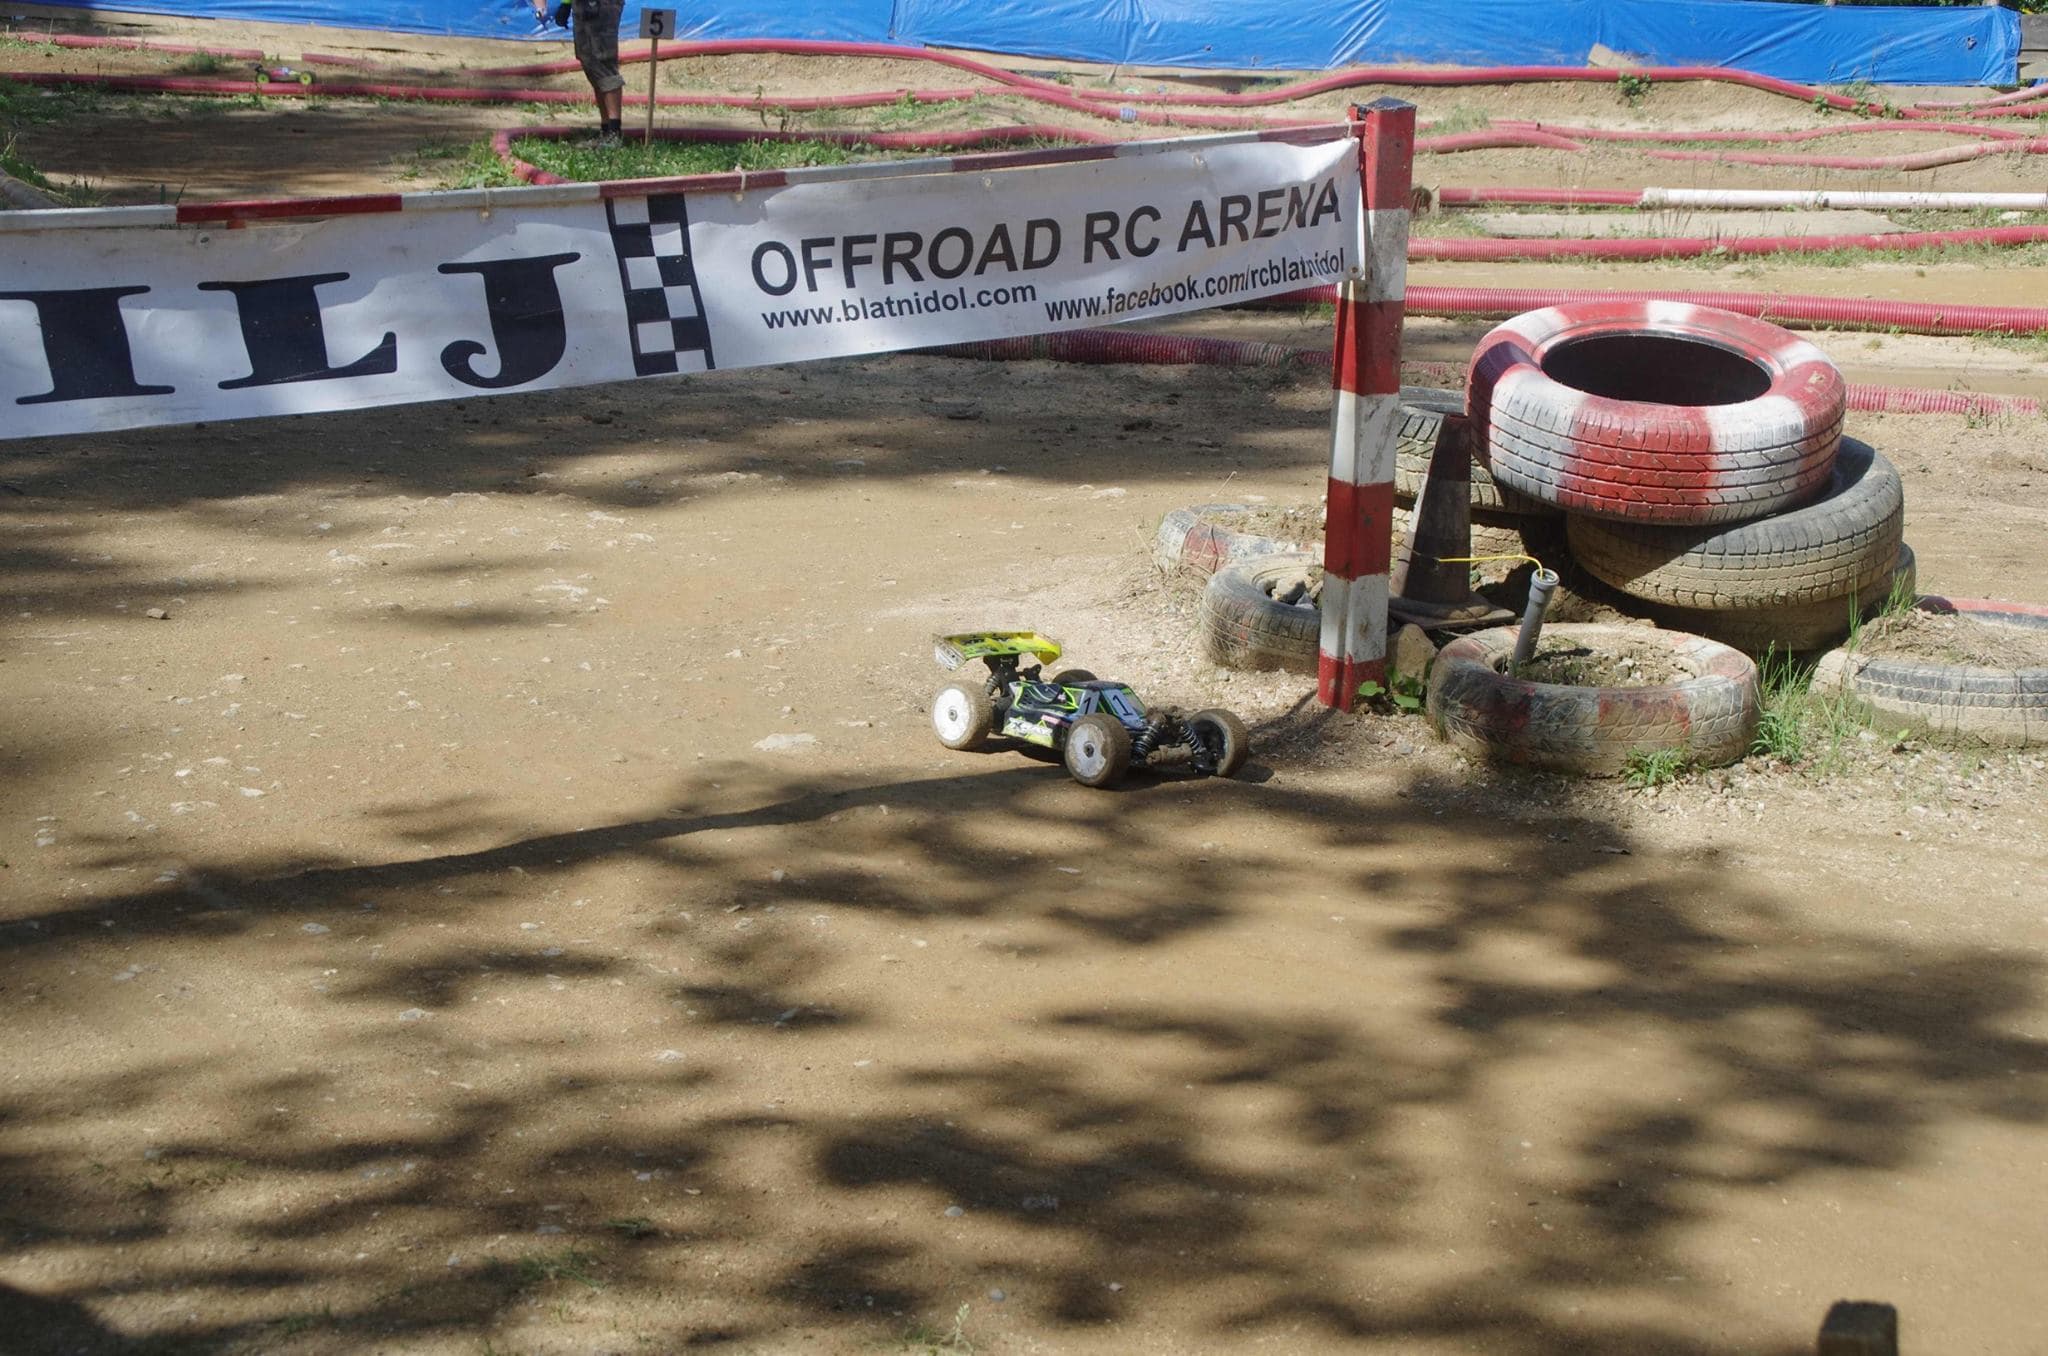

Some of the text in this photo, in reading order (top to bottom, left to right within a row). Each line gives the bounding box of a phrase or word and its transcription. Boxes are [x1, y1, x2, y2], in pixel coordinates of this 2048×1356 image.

[649, 11, 664, 36] 5
[750, 177, 1343, 297] OFFROAD RC ARENA
[761, 284, 1037, 330] www.blatnidol.com
[1045, 248, 1346, 322] www.facebook.com/rcblatnidol
